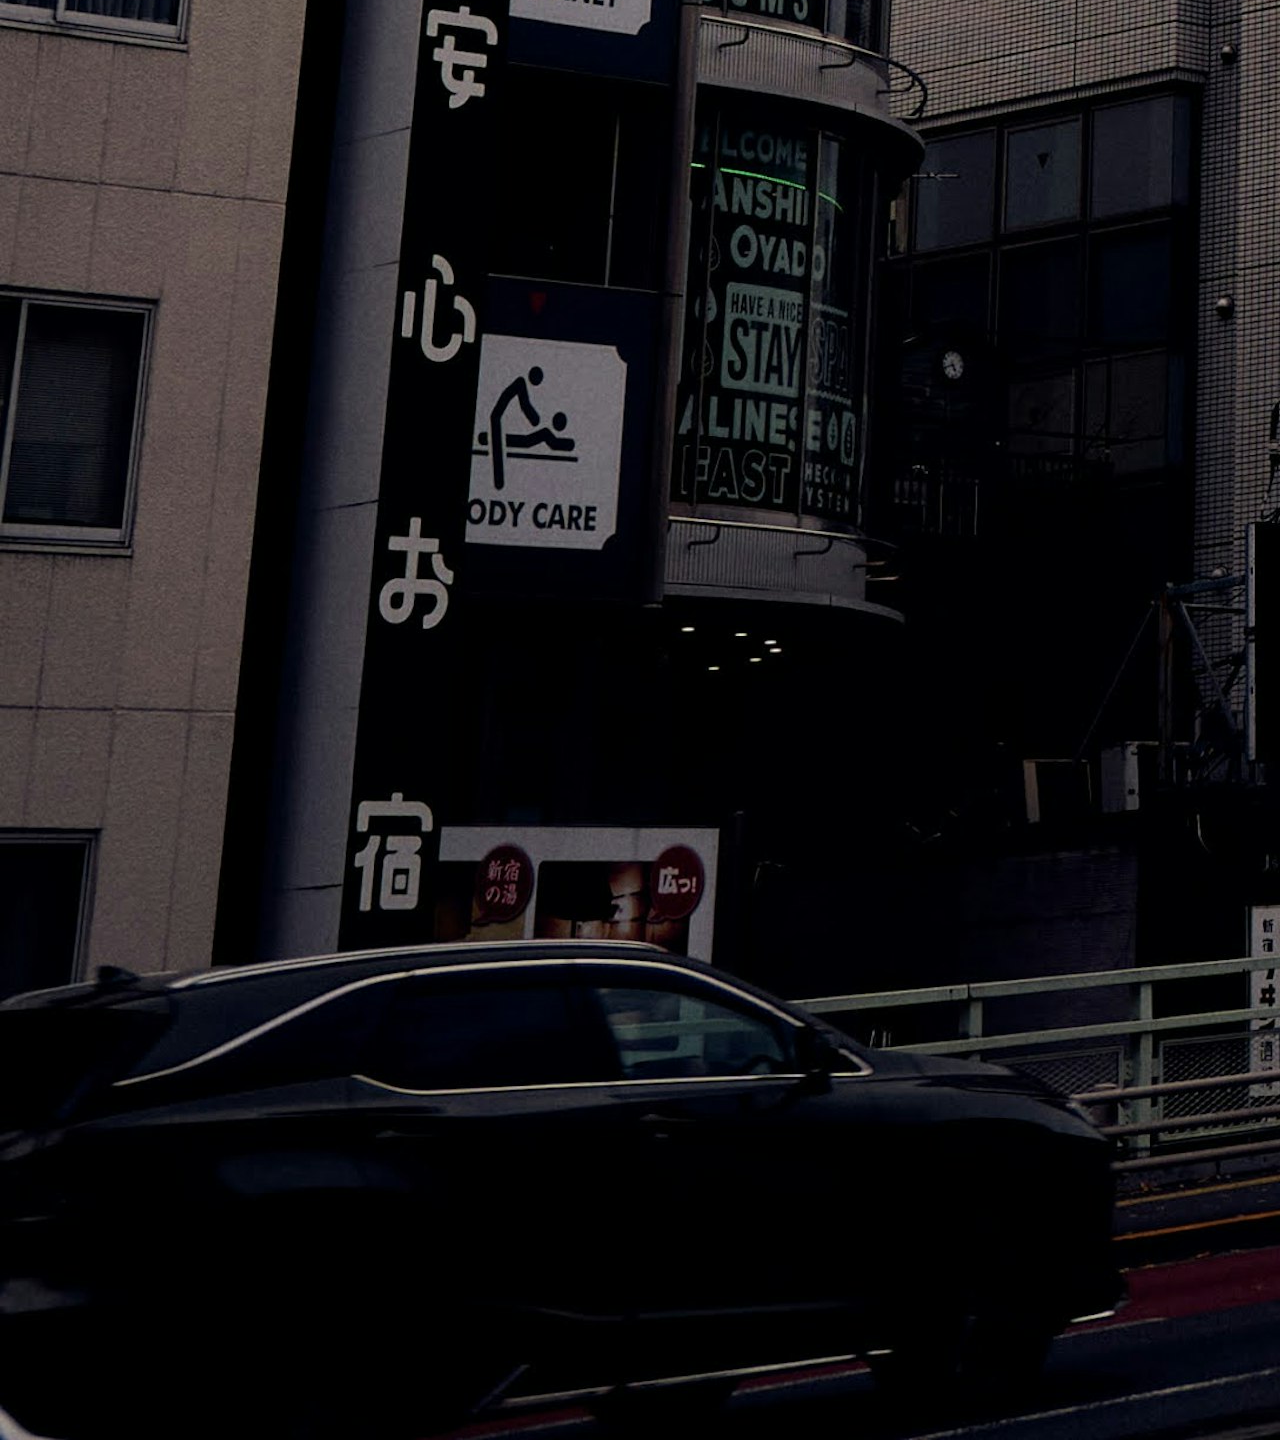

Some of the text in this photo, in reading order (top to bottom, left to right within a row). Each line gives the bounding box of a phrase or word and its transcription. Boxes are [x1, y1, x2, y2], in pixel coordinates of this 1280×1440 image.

[731, 292, 764, 317] HAVE
[766, 297, 774, 314] A
[727, 317, 803, 388] STAY
[531, 501, 598, 533] CARE
